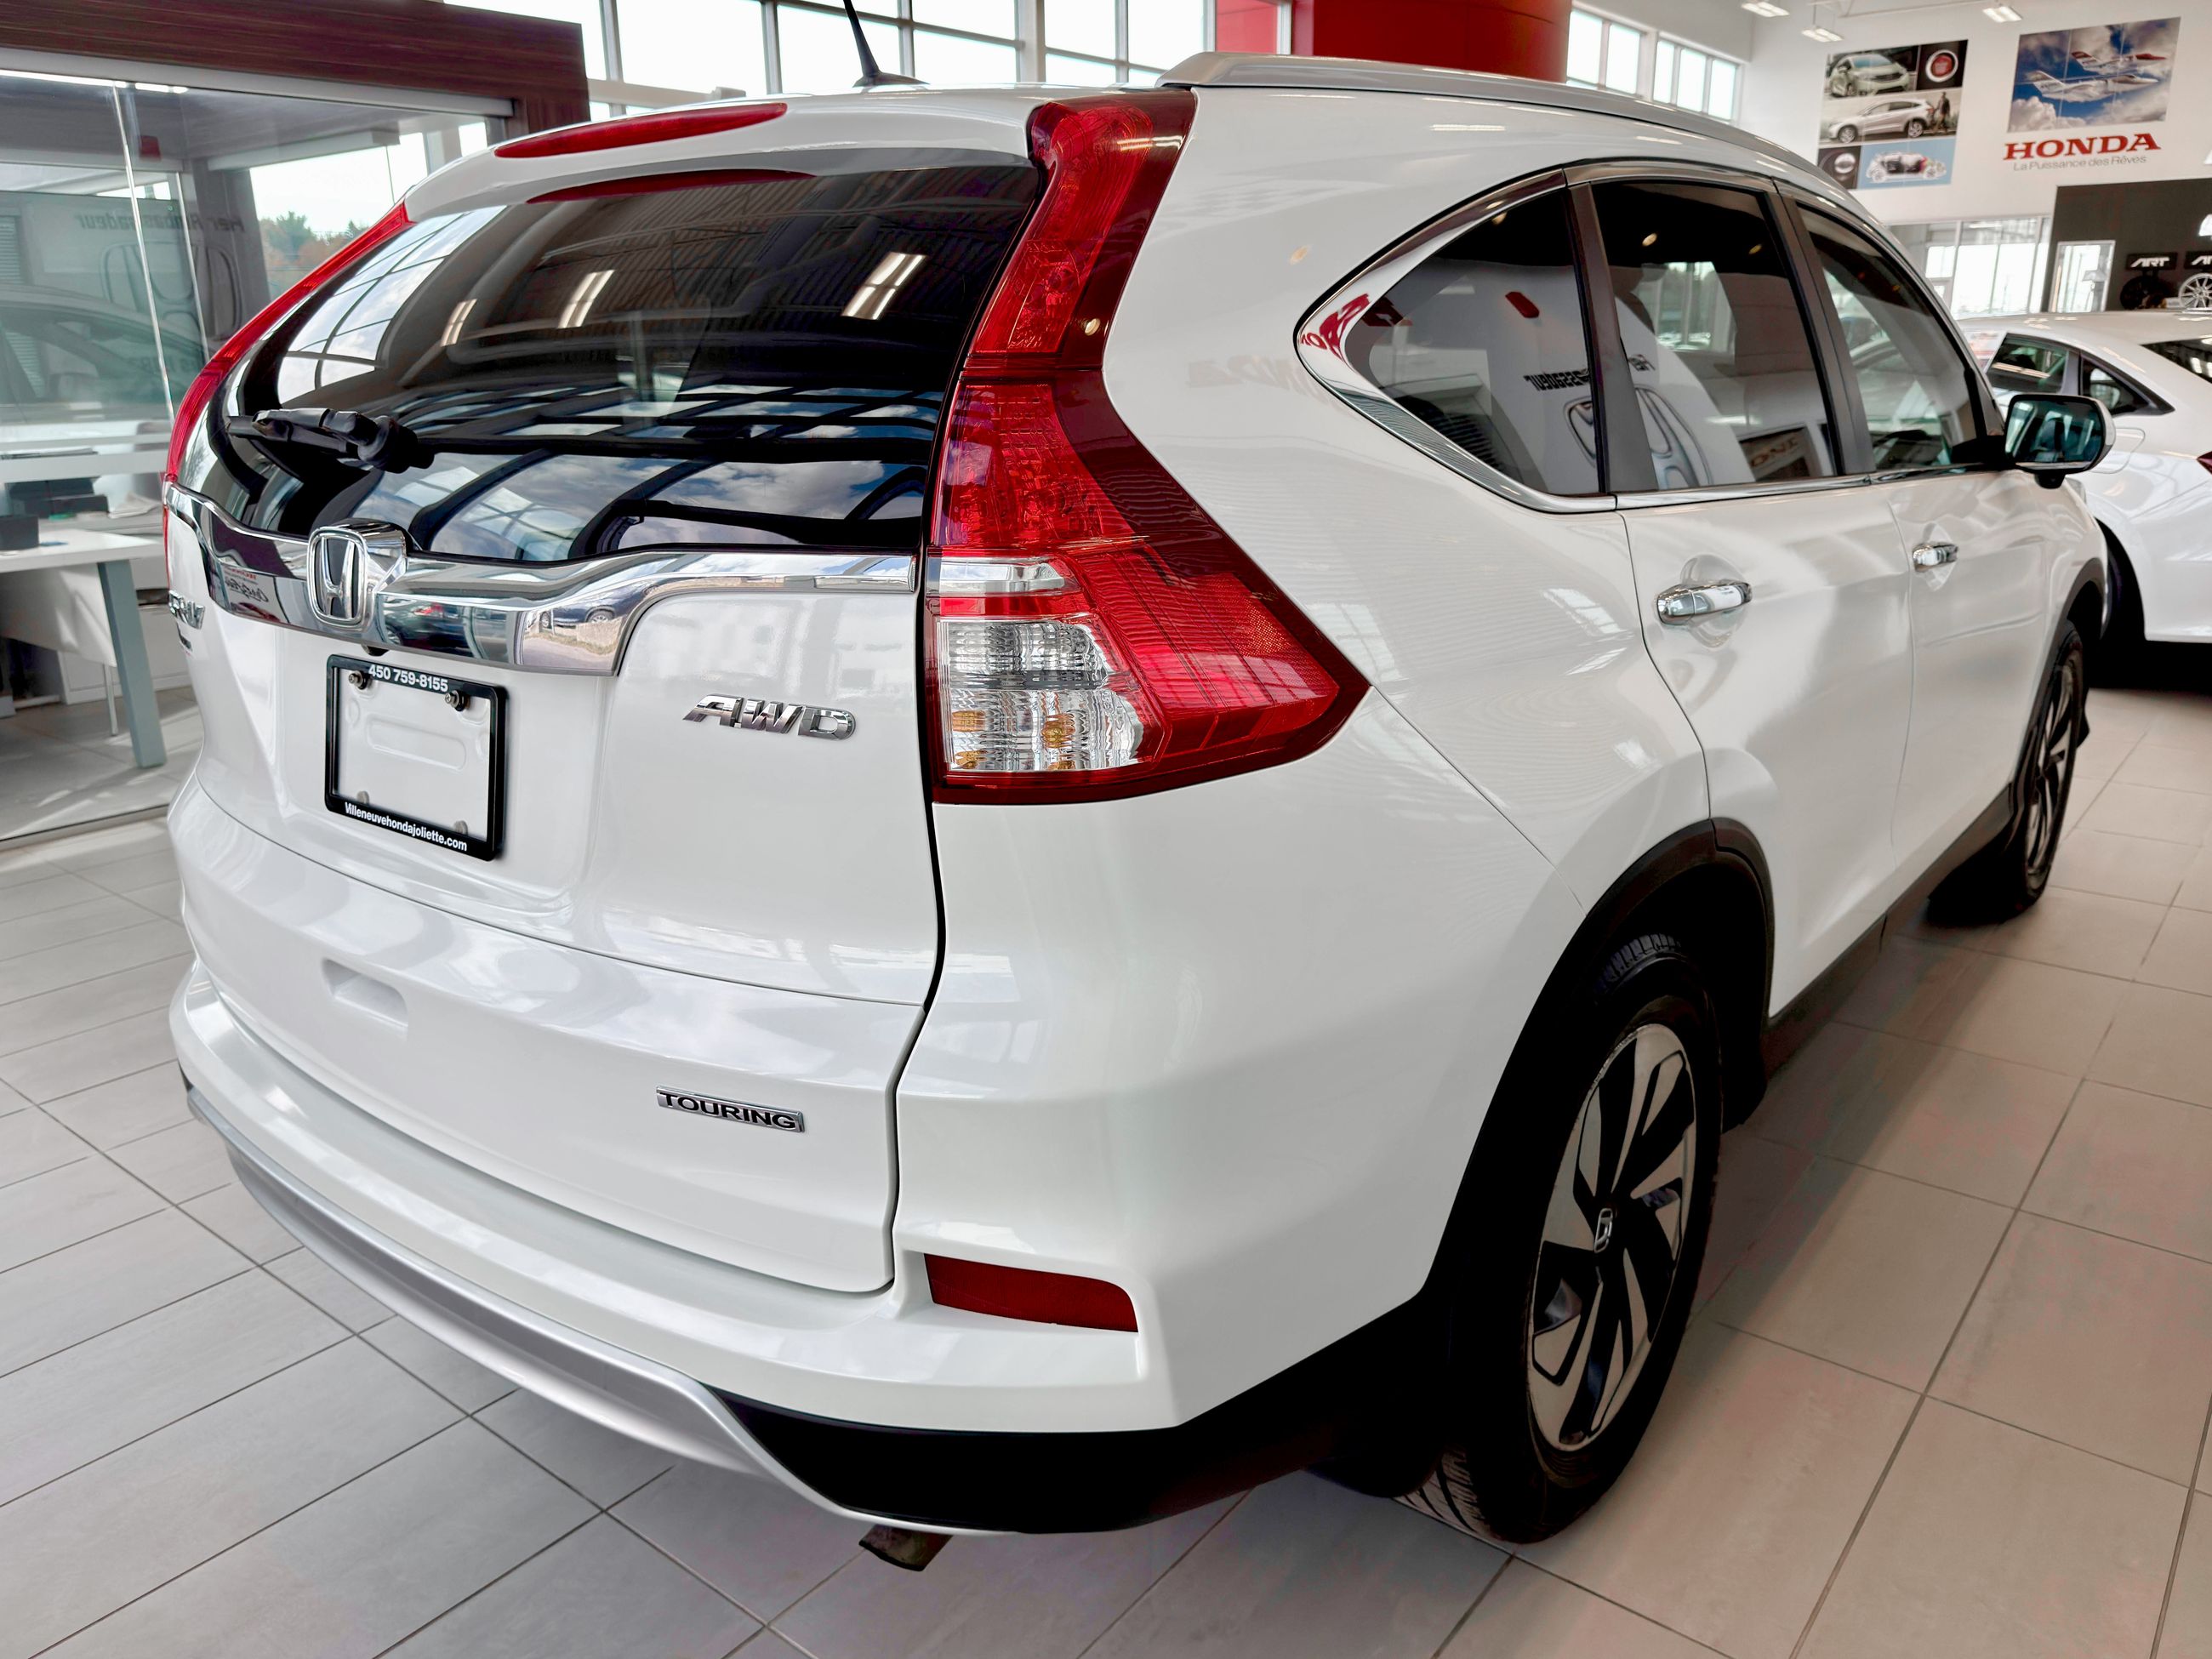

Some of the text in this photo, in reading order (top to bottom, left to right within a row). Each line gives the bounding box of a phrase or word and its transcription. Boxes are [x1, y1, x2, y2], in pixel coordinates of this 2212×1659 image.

[2004, 133, 2161, 160] HONDA
[2014, 154, 2147, 171] La Puissance des Rêves
[2130, 257, 2170, 268] ART
[368, 664, 449, 693] 450 759-8155
[682, 693, 857, 741] AWD
[345, 801, 468, 851] Villeneuvehondajoliette.com
[659, 1092, 796, 1129] TOURING
